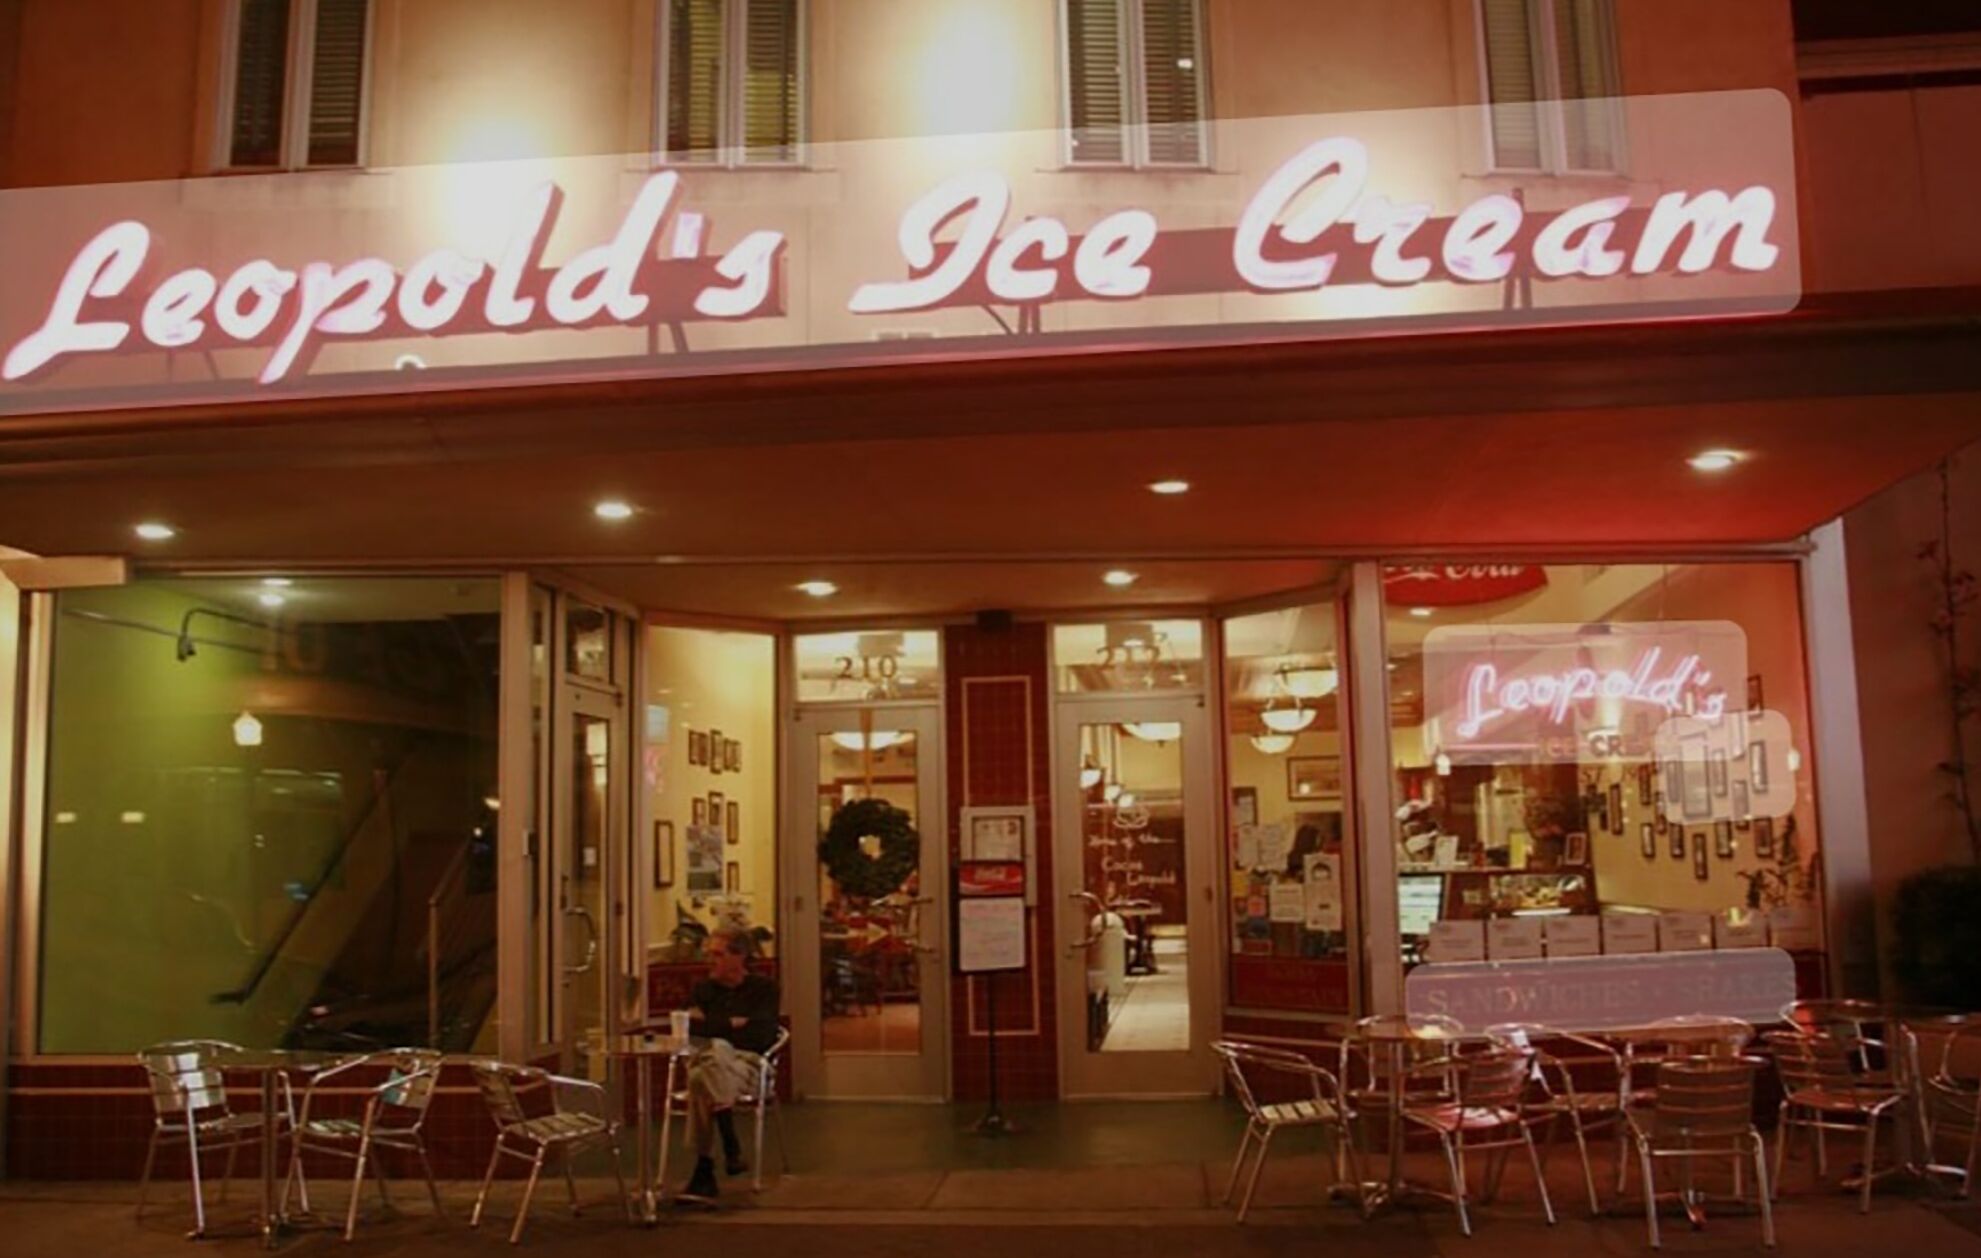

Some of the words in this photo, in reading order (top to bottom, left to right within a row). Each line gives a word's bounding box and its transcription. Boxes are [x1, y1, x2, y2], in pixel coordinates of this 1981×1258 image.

[3, 169, 785, 384] Leopold's
[849, 173, 1157, 313] Ice
[1233, 136, 1779, 289] Cream
[834, 654, 897, 679] 210
[1457, 646, 1727, 738] Leopold's
